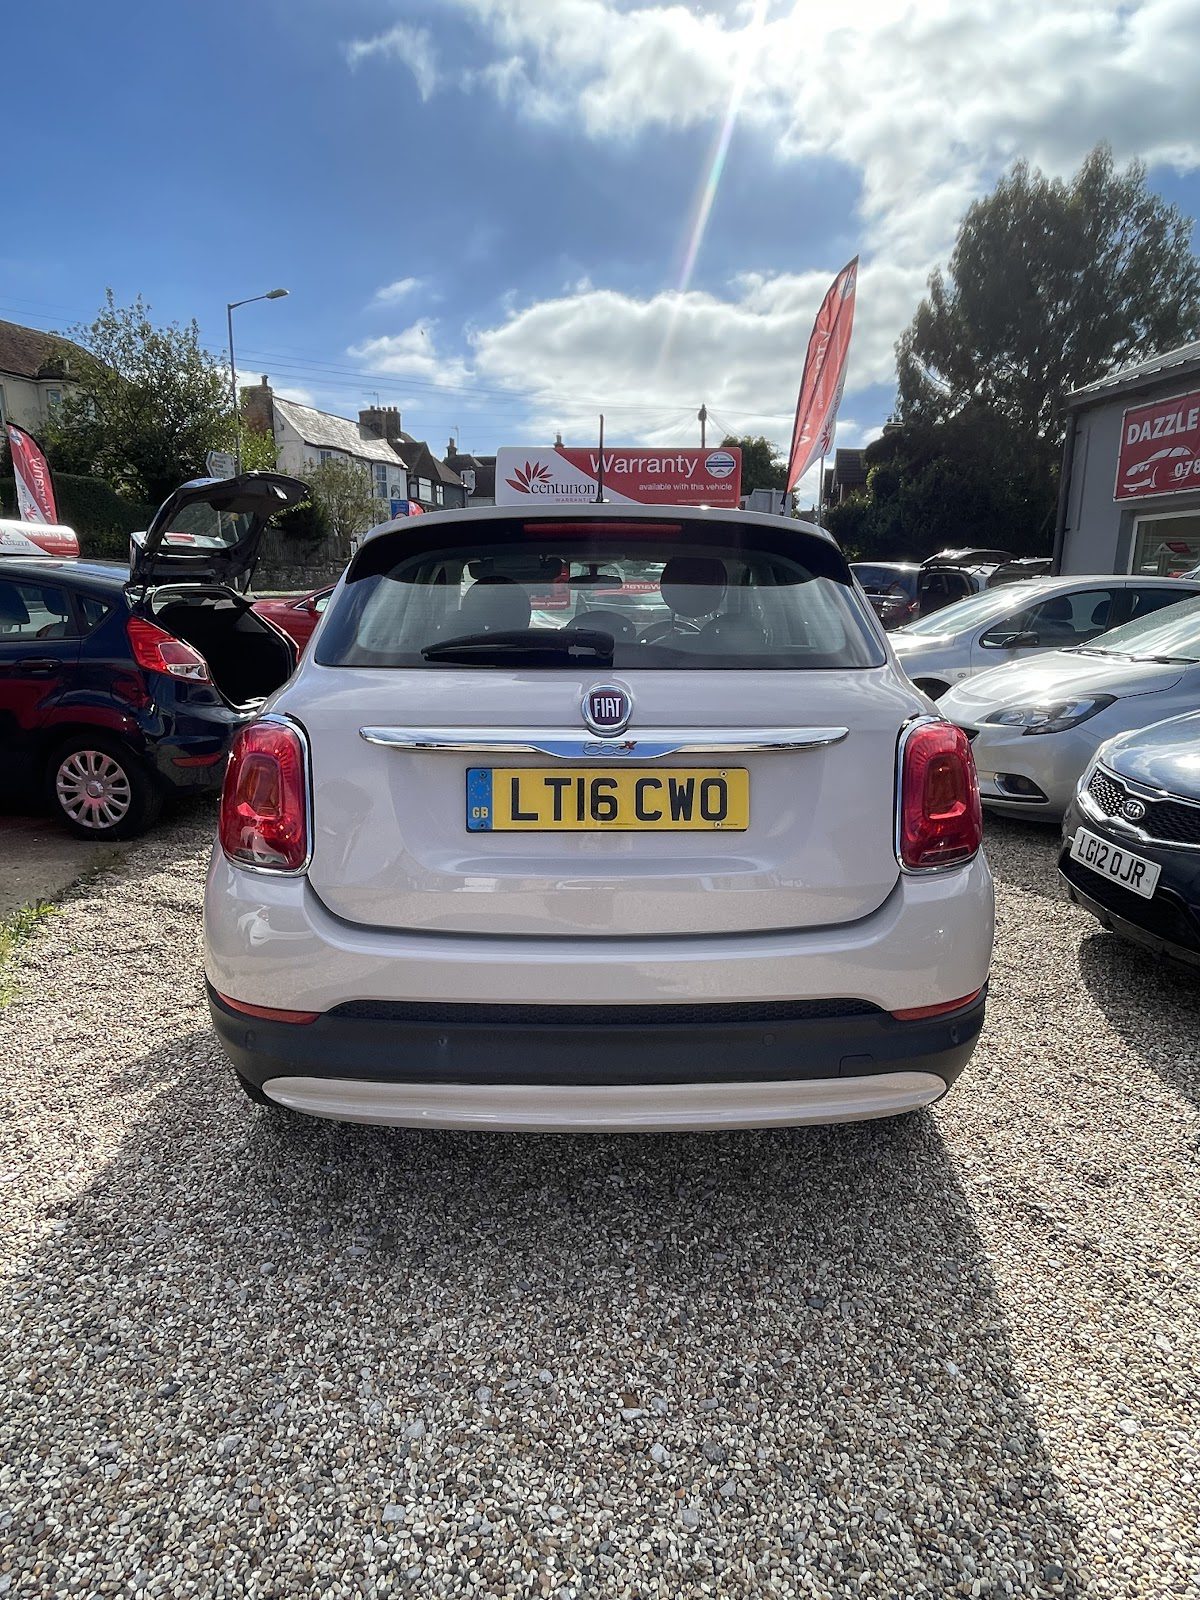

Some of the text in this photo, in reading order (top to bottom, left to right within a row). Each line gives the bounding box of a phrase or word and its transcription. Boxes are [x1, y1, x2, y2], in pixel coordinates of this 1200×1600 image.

[1126, 407, 1200, 445] DAZZLE
[590, 453, 698, 478] Warranty
[531, 483, 595, 494] centurion
[593, 697, 621, 718] FIAT
[472, 806, 489, 818] GB
[510, 777, 728, 822] LT16 CWO
[1077, 835, 1146, 888] LG12 OJR
